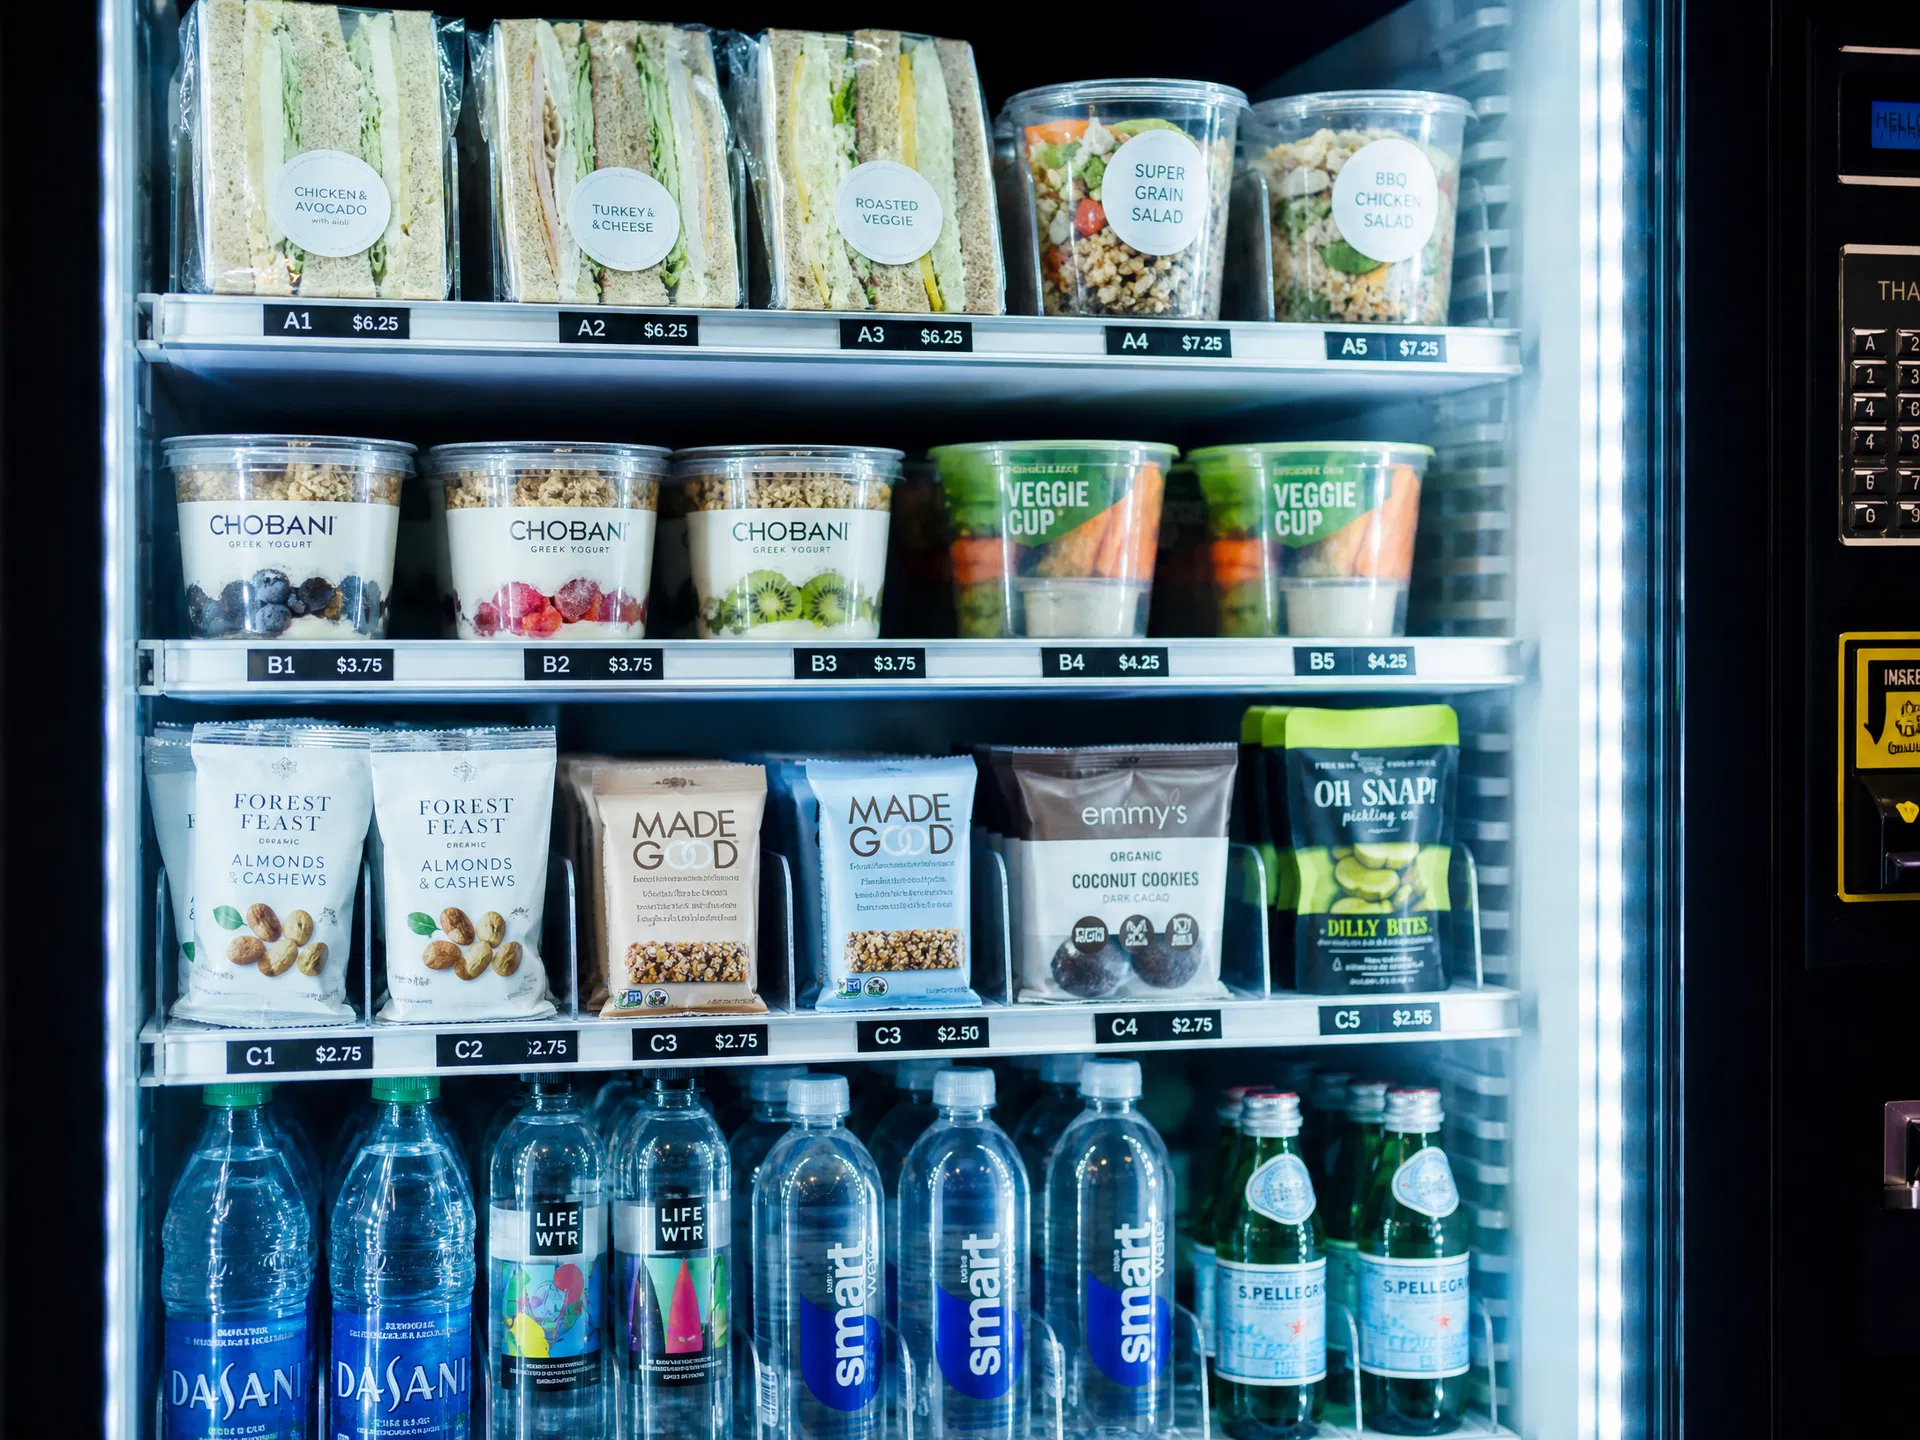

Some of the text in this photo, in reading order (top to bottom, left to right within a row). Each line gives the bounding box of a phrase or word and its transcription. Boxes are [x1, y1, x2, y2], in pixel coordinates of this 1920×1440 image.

[1135, 164, 1185, 180] SUPER
[1376, 172, 1407, 188] BBQ
[294, 186, 367, 200] CHICKEN &
[1135, 186, 1183, 201] GRAIN
[1355, 192, 1422, 208] CHICKEN
[294, 202, 367, 215] AVOCADO
[592, 204, 654, 217] TURKEY &
[856, 198, 918, 211] ROASTED
[862, 214, 914, 226] VEGGIE
[1132, 208, 1183, 223] SALAD
[1364, 214, 1414, 229] SALAD
[592, 220, 654, 232] & CHEESE
[284, 312, 398, 332] A1 $6.25
[578, 320, 688, 338] A2 $6.25
[858, 326, 962, 345] A3 $6.25
[1122, 333, 1222, 351] A4 $7.25
[1865, 336, 1875, 350] A
[1911, 336, 1920, 351] 2
[1342, 338, 1439, 356] A5 $7.25
[1911, 368, 1920, 384] 3
[1866, 401, 1875, 416] 4
[1866, 433, 1875, 449] 4
[1912, 475, 1920, 490] 7
[1006, 480, 1089, 508] VEGGIE
[1273, 481, 1356, 509] VEGGIE
[1008, 509, 1055, 535] CUP
[1275, 509, 1323, 536] CUP
[1912, 508, 1920, 522] 9
[210, 514, 334, 536] CHOBANI
[509, 520, 626, 541] CHOBANI
[732, 522, 848, 541] CHOBANI
[571, 546, 610, 554] YOGURT
[268, 656, 382, 674] B1 $3.75
[543, 656, 652, 673] B2 $3.75
[812, 655, 916, 672] B3 $3.75
[1059, 654, 1160, 671] B4 $4.25
[1310, 652, 1408, 670] B5 $4.25
[1314, 776, 1438, 808] OH SNAP!
[233, 793, 332, 812] FOREST
[419, 798, 514, 815] FOREST
[849, 793, 952, 824] MADE
[240, 813, 321, 832] FEAST
[632, 810, 737, 839] MADE
[1082, 805, 1188, 830] emmy's
[1342, 809, 1418, 827] pickling co.
[426, 818, 506, 835] FEAST
[850, 824, 954, 857] GOOD
[232, 854, 325, 869] ALMONDS
[633, 840, 738, 870] GOOD
[1110, 851, 1162, 862] ORGANIC
[421, 857, 513, 872] ALMONDS
[228, 872, 327, 886] & CASHEWS
[419, 874, 515, 889] & CASHEWS
[1072, 872, 1199, 889] COCONUT COOKIES
[1103, 893, 1170, 904] DARK CACAO
[1328, 916, 1428, 937] DILLY BITES
[1111, 1017, 1213, 1036] C4 $2.75
[1335, 1009, 1432, 1029] C5 $2.55
[650, 1033, 758, 1052] C3 $2.75
[875, 1026, 979, 1044] C3 $2.50
[246, 1045, 362, 1066] C1 $2.75
[455, 1040, 483, 1058] C2
[536, 1211, 578, 1227] LIFE
[661, 1206, 703, 1222] LIFE
[536, 1230, 578, 1246] WTR
[662, 1225, 703, 1242] WTR
[1114, 1221, 1151, 1363] smart
[962, 1232, 1000, 1376] smart
[827, 1242, 864, 1387] smart
[172, 1362, 302, 1420] DASANI
[338, 1356, 466, 1412] DASANI
